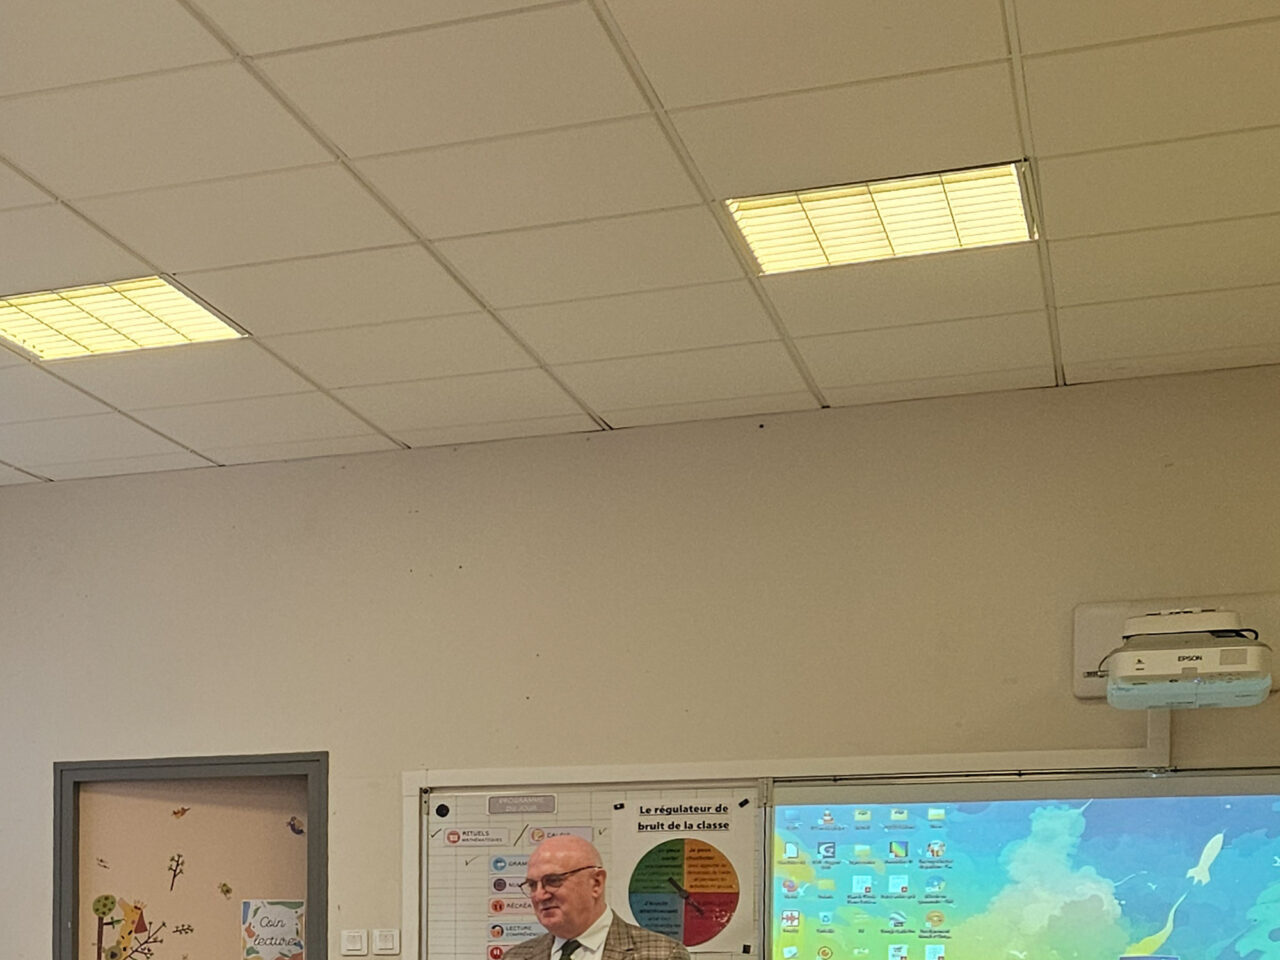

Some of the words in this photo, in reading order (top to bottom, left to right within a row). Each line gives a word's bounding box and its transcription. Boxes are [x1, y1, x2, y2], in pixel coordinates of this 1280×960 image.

[640, 806, 651, 814] Le
[654, 804, 712, 815] régulateur
[715, 804, 729, 812] de
[638, 822, 665, 831] bruit
[668, 821, 681, 830] de
[684, 821, 694, 829] la
[697, 821, 730, 829] classe
[259, 916, 286, 928] Coin
[254, 934, 295, 946] lecture
